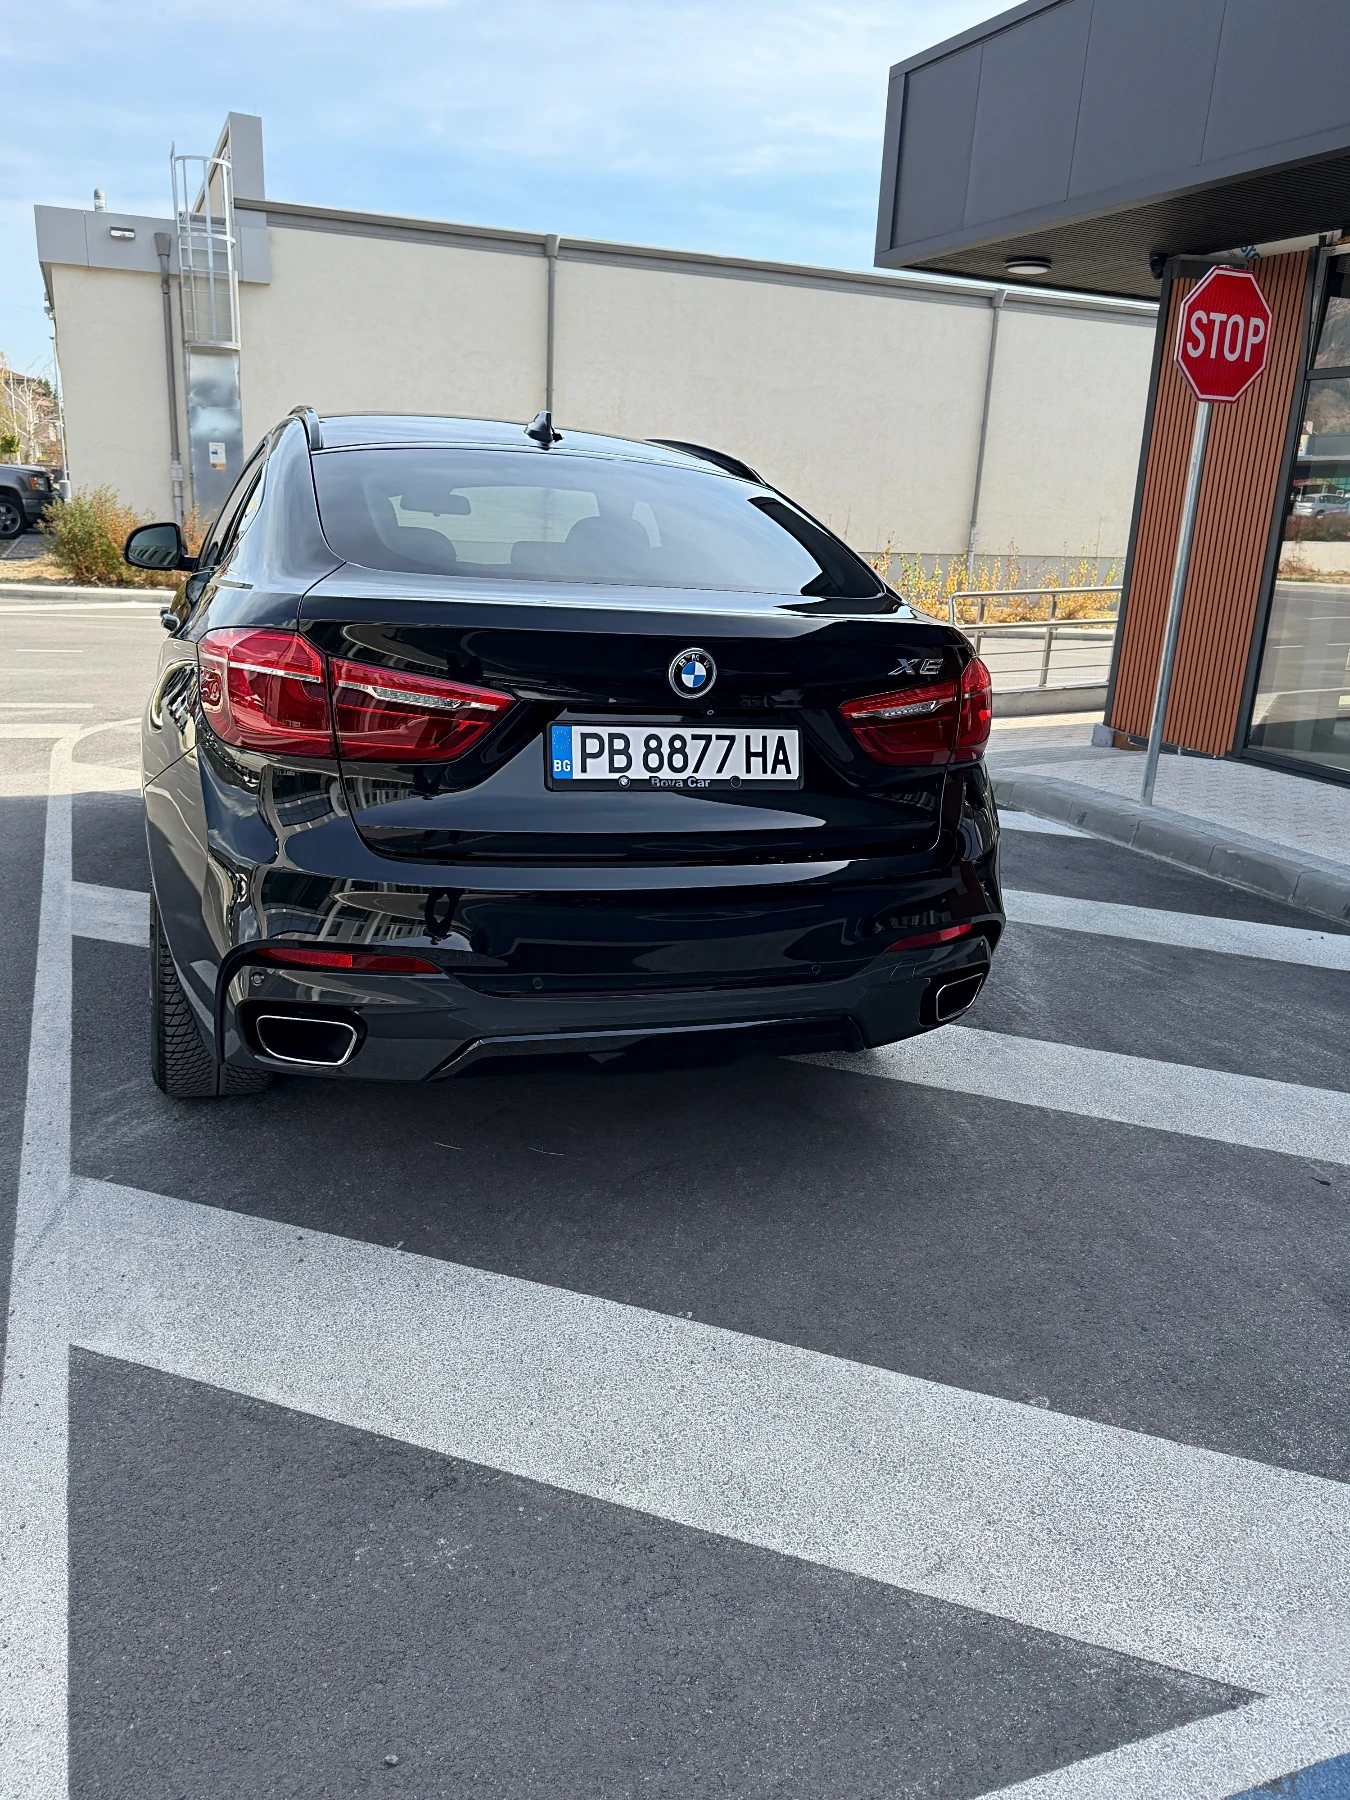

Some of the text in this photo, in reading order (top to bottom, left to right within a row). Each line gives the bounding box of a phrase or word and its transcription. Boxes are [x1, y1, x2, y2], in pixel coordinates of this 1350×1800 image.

[1186, 310, 1265, 363] STOP
[678, 654, 712, 669] BMW
[888, 658, 944, 676] X6
[580, 732, 792, 774] PB 8877 HA
[553, 760, 571, 772] BG
[687, 777, 711, 788] Car
